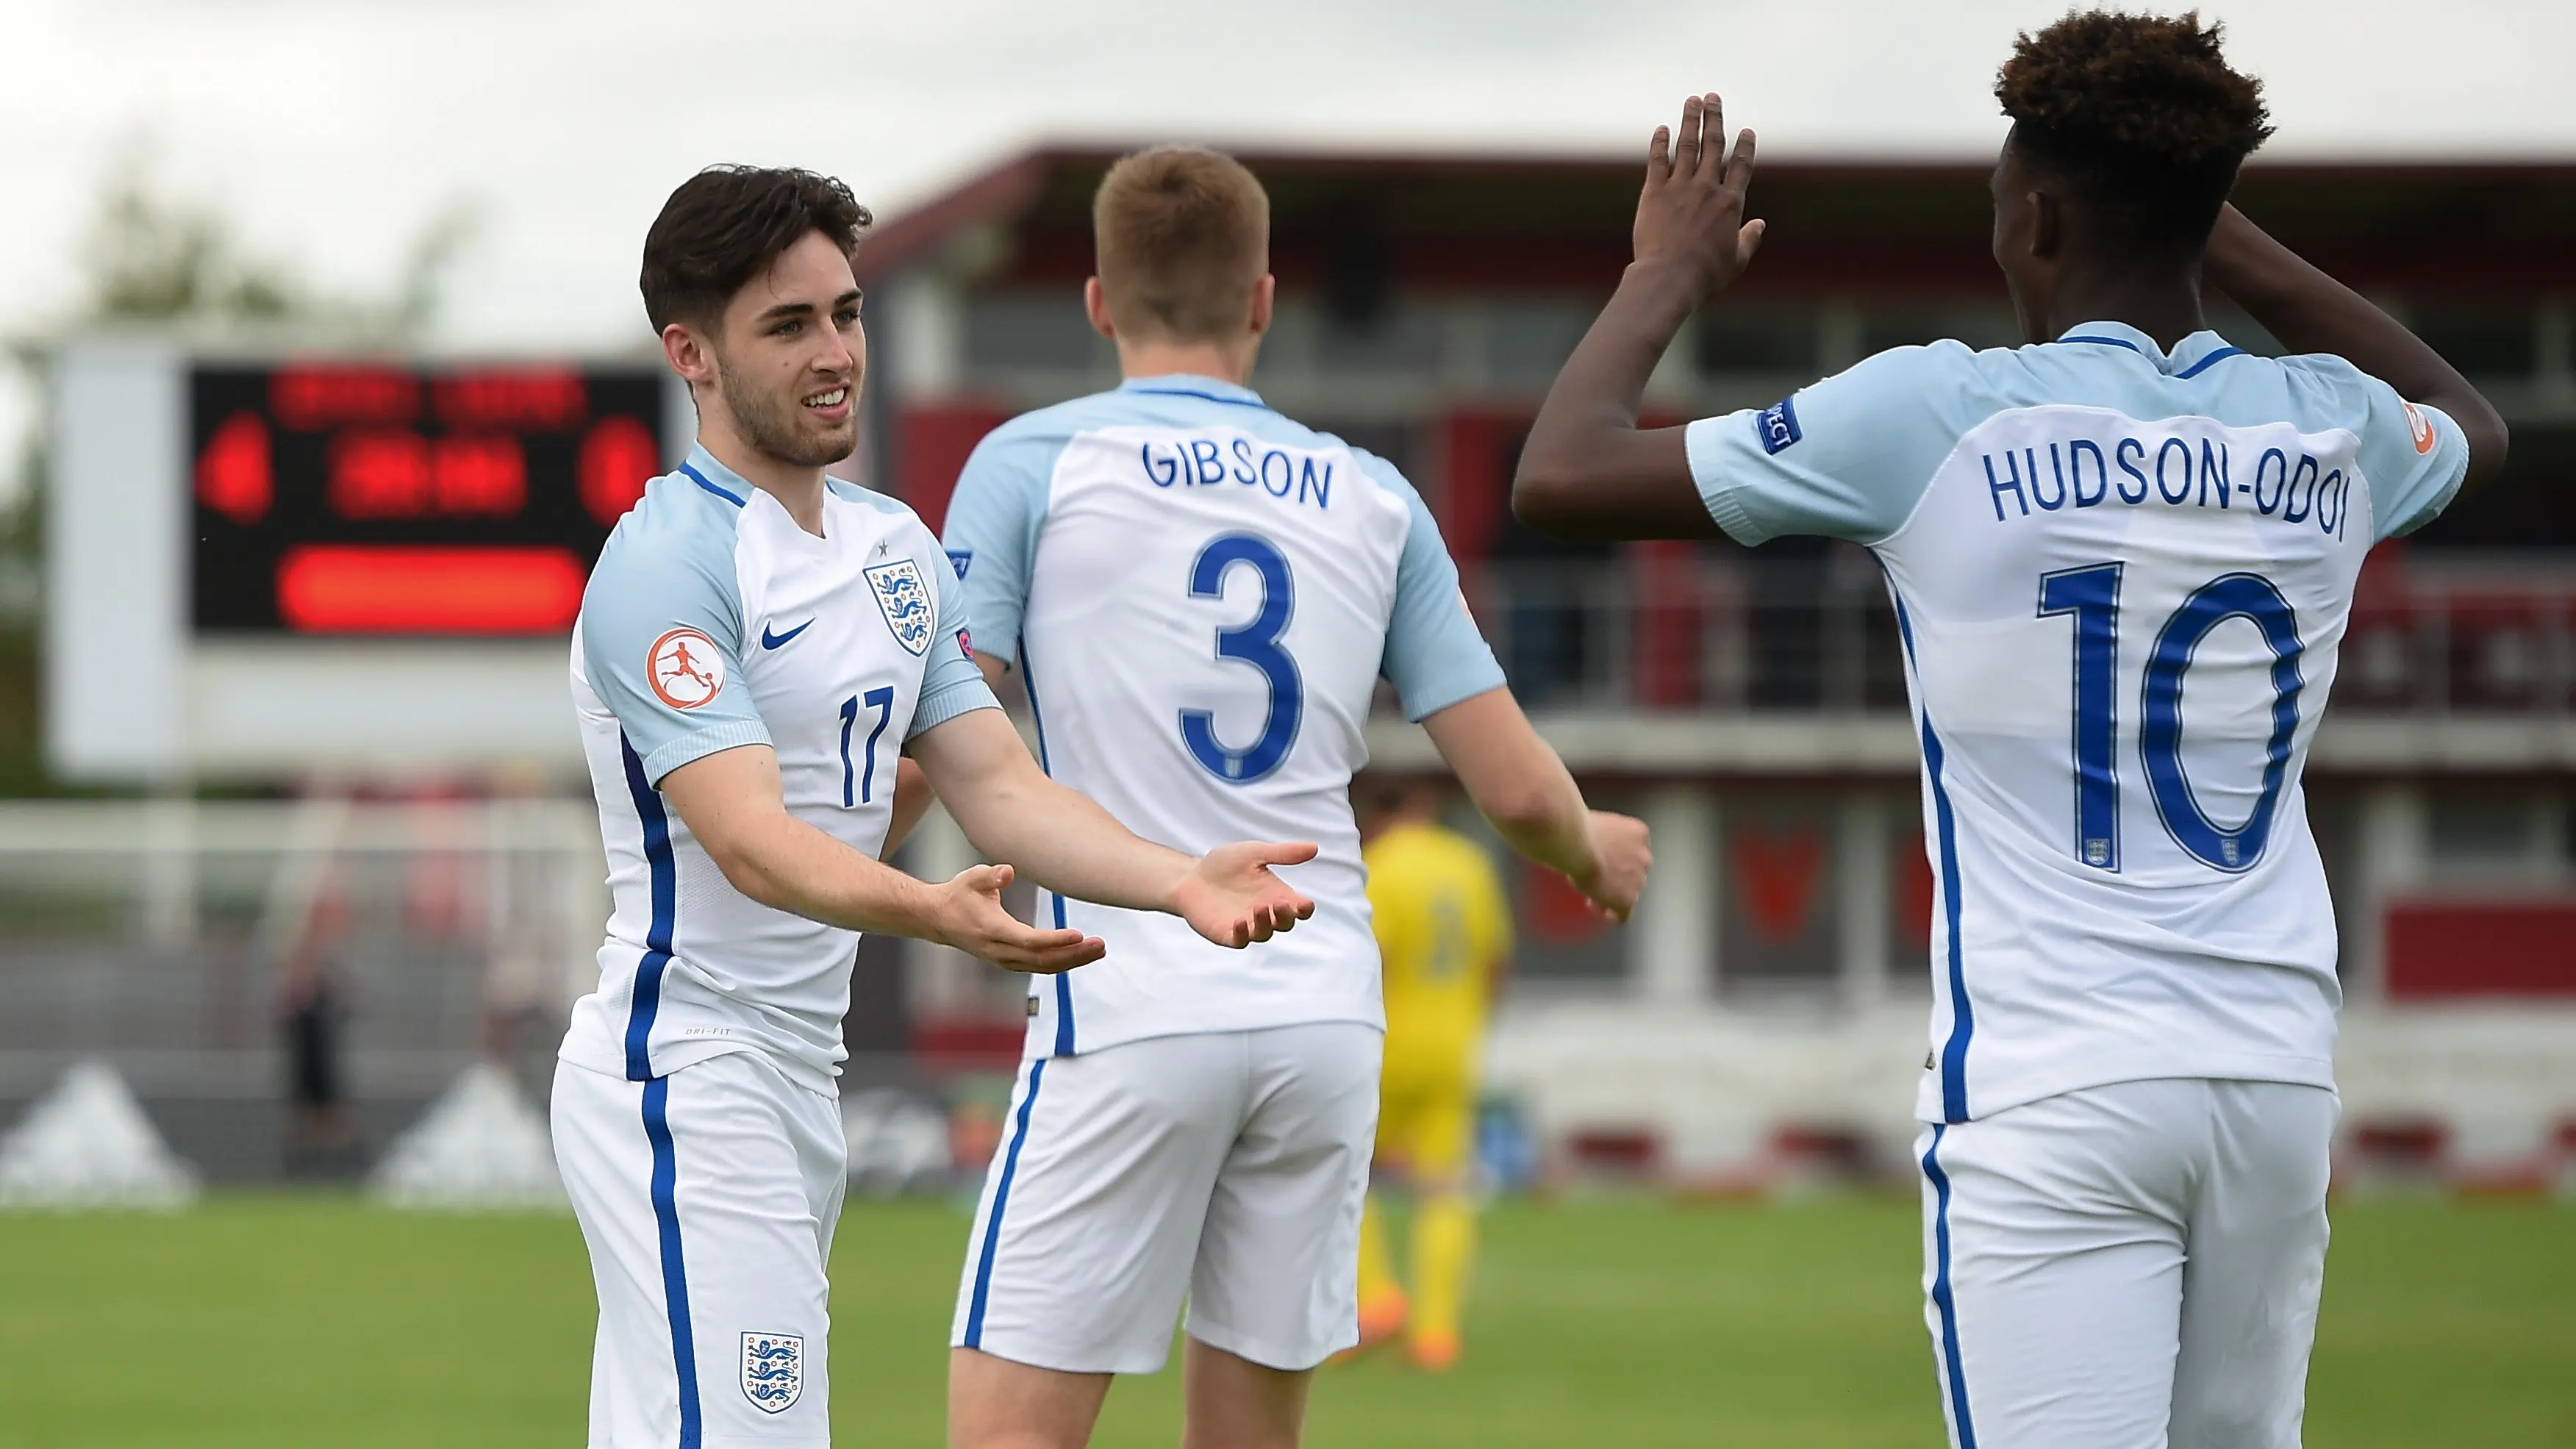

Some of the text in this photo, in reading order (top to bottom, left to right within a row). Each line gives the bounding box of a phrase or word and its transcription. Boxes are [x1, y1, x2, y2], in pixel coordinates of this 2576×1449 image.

[1142, 437, 1334, 510] GIBSON
[1982, 437, 2351, 543] HUDSON-ODOI
[1178, 529, 1305, 786] 3
[2036, 560, 2306, 874] 10
[838, 685, 894, 809] 17
